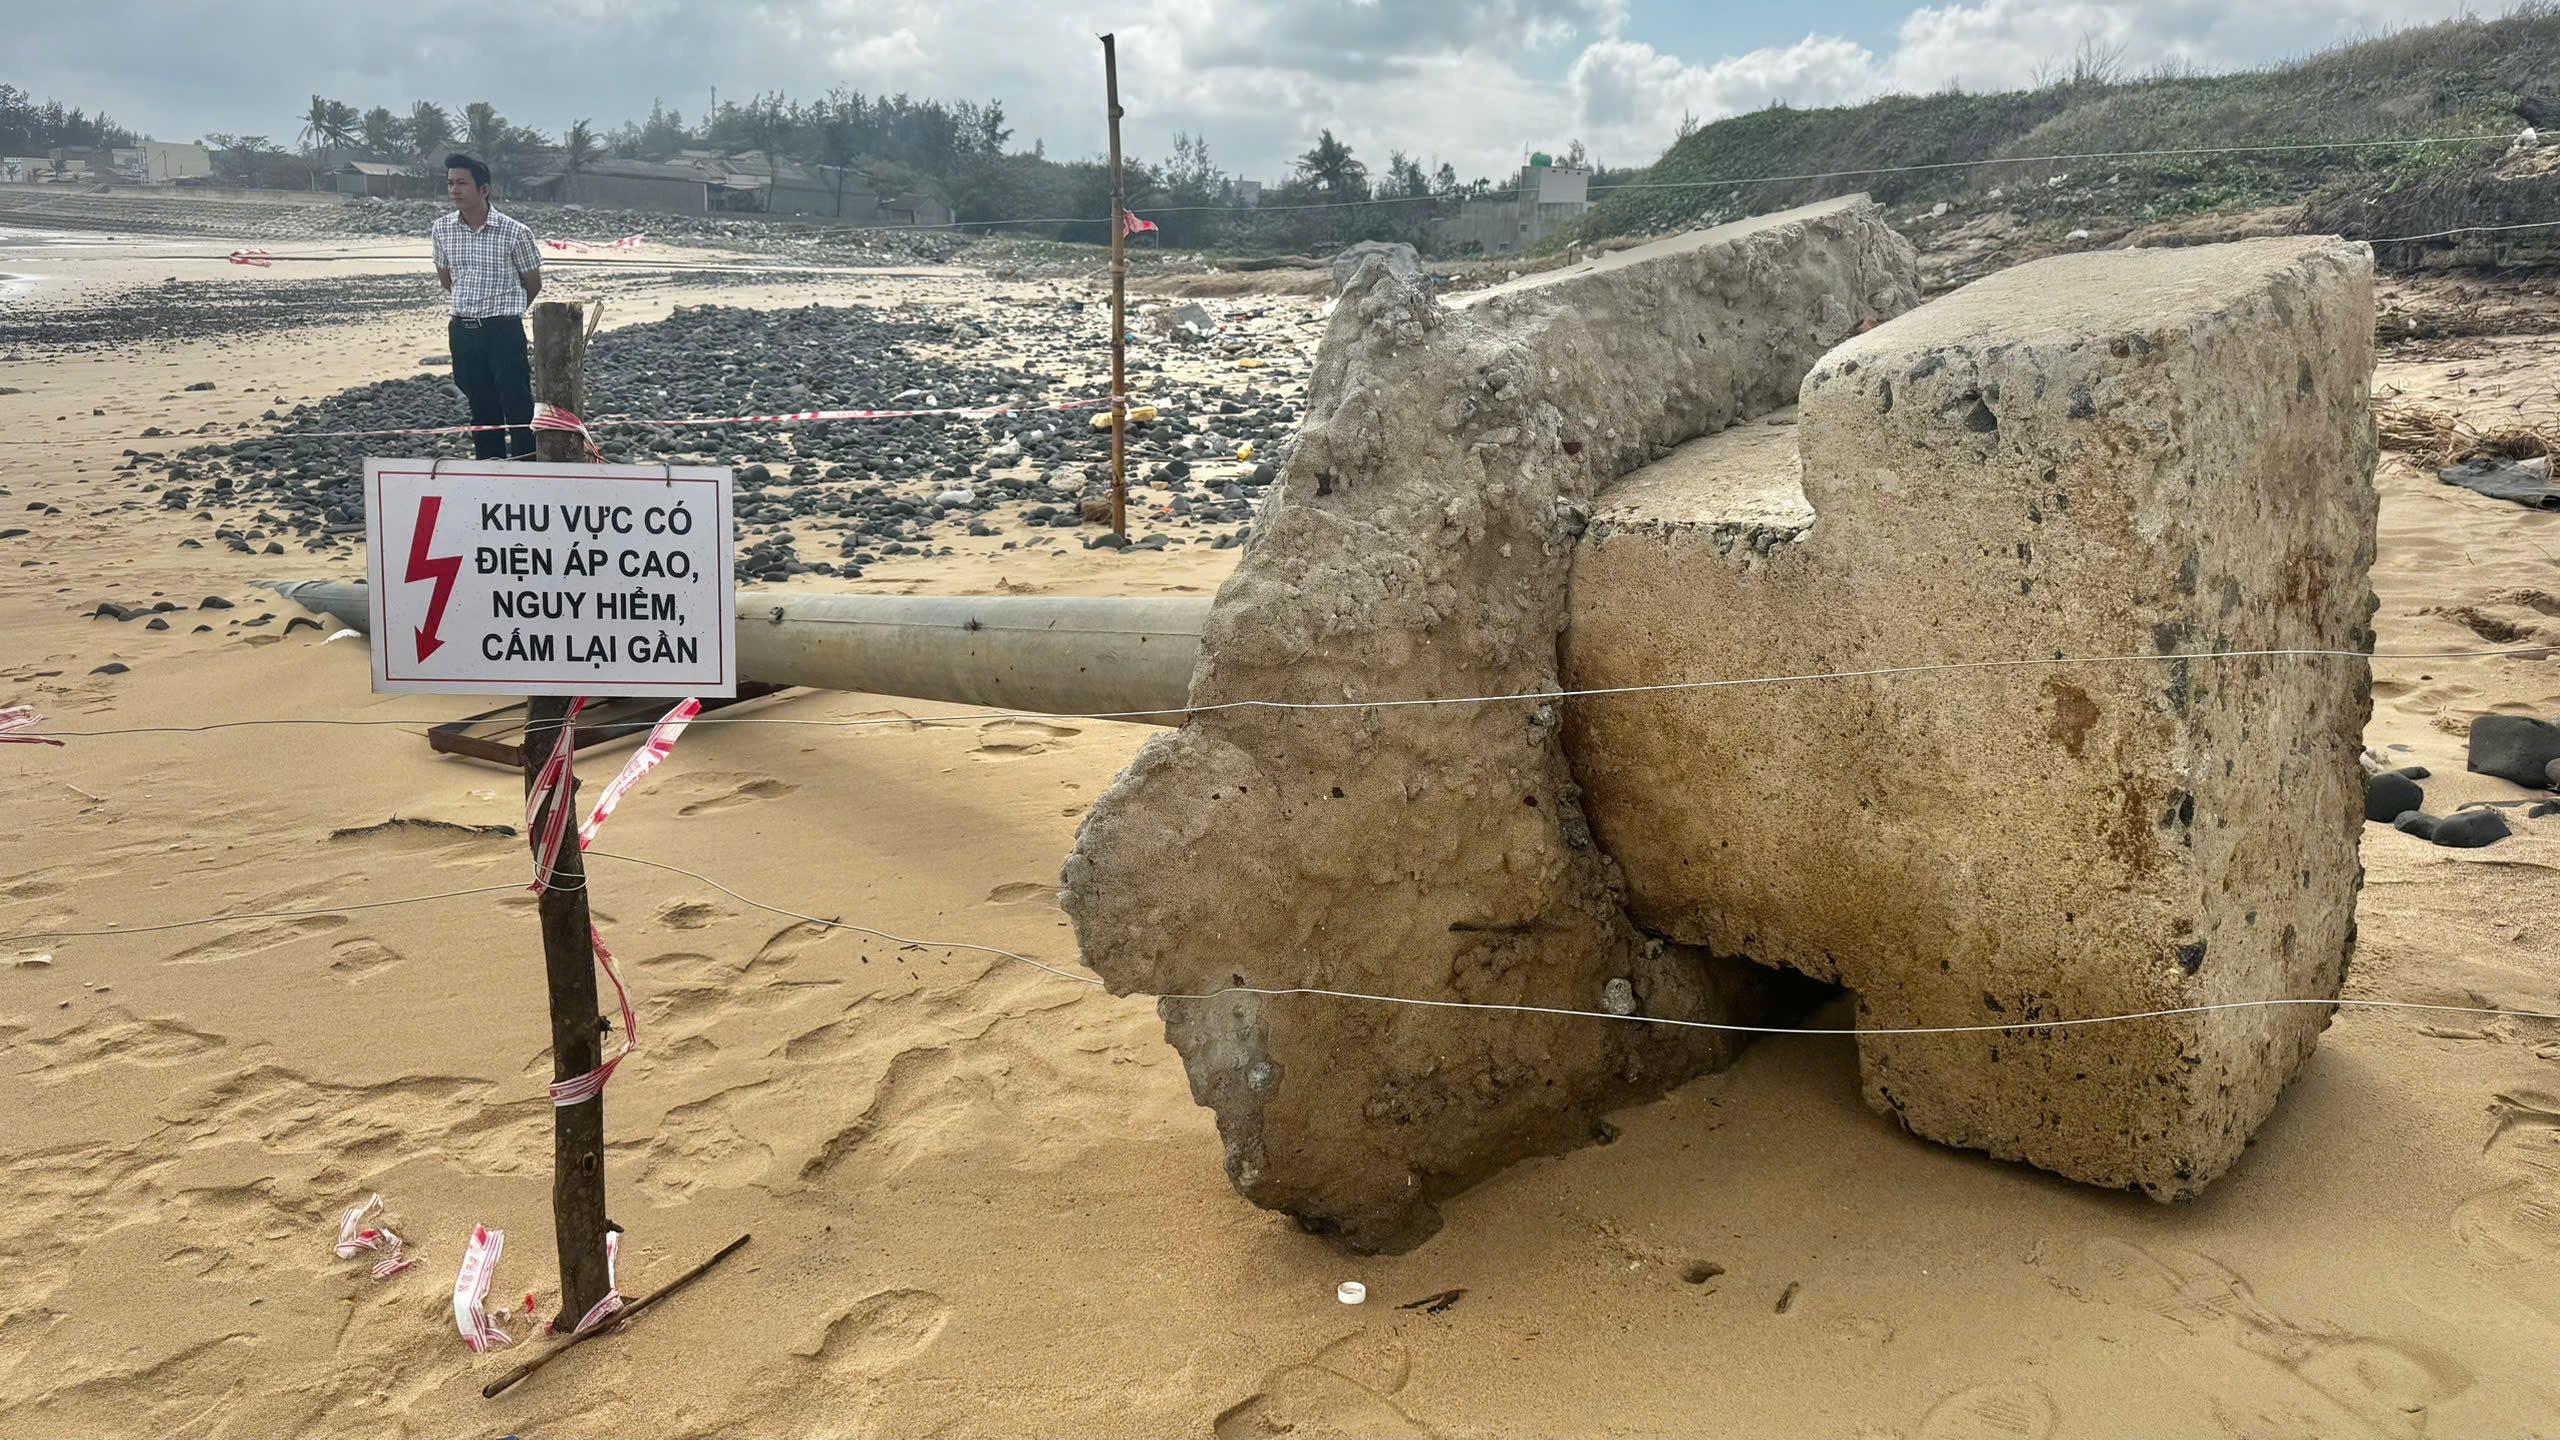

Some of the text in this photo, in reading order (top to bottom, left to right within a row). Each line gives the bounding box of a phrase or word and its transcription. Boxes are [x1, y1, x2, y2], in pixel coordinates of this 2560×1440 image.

[482, 501, 692, 540] KHU VỰC CÓ
[475, 541, 699, 584] ĐIỆN ÁP CAO,
[493, 586, 685, 626] NGUY HIỂM,
[482, 628, 698, 669] CẤM LẠI GẦN
